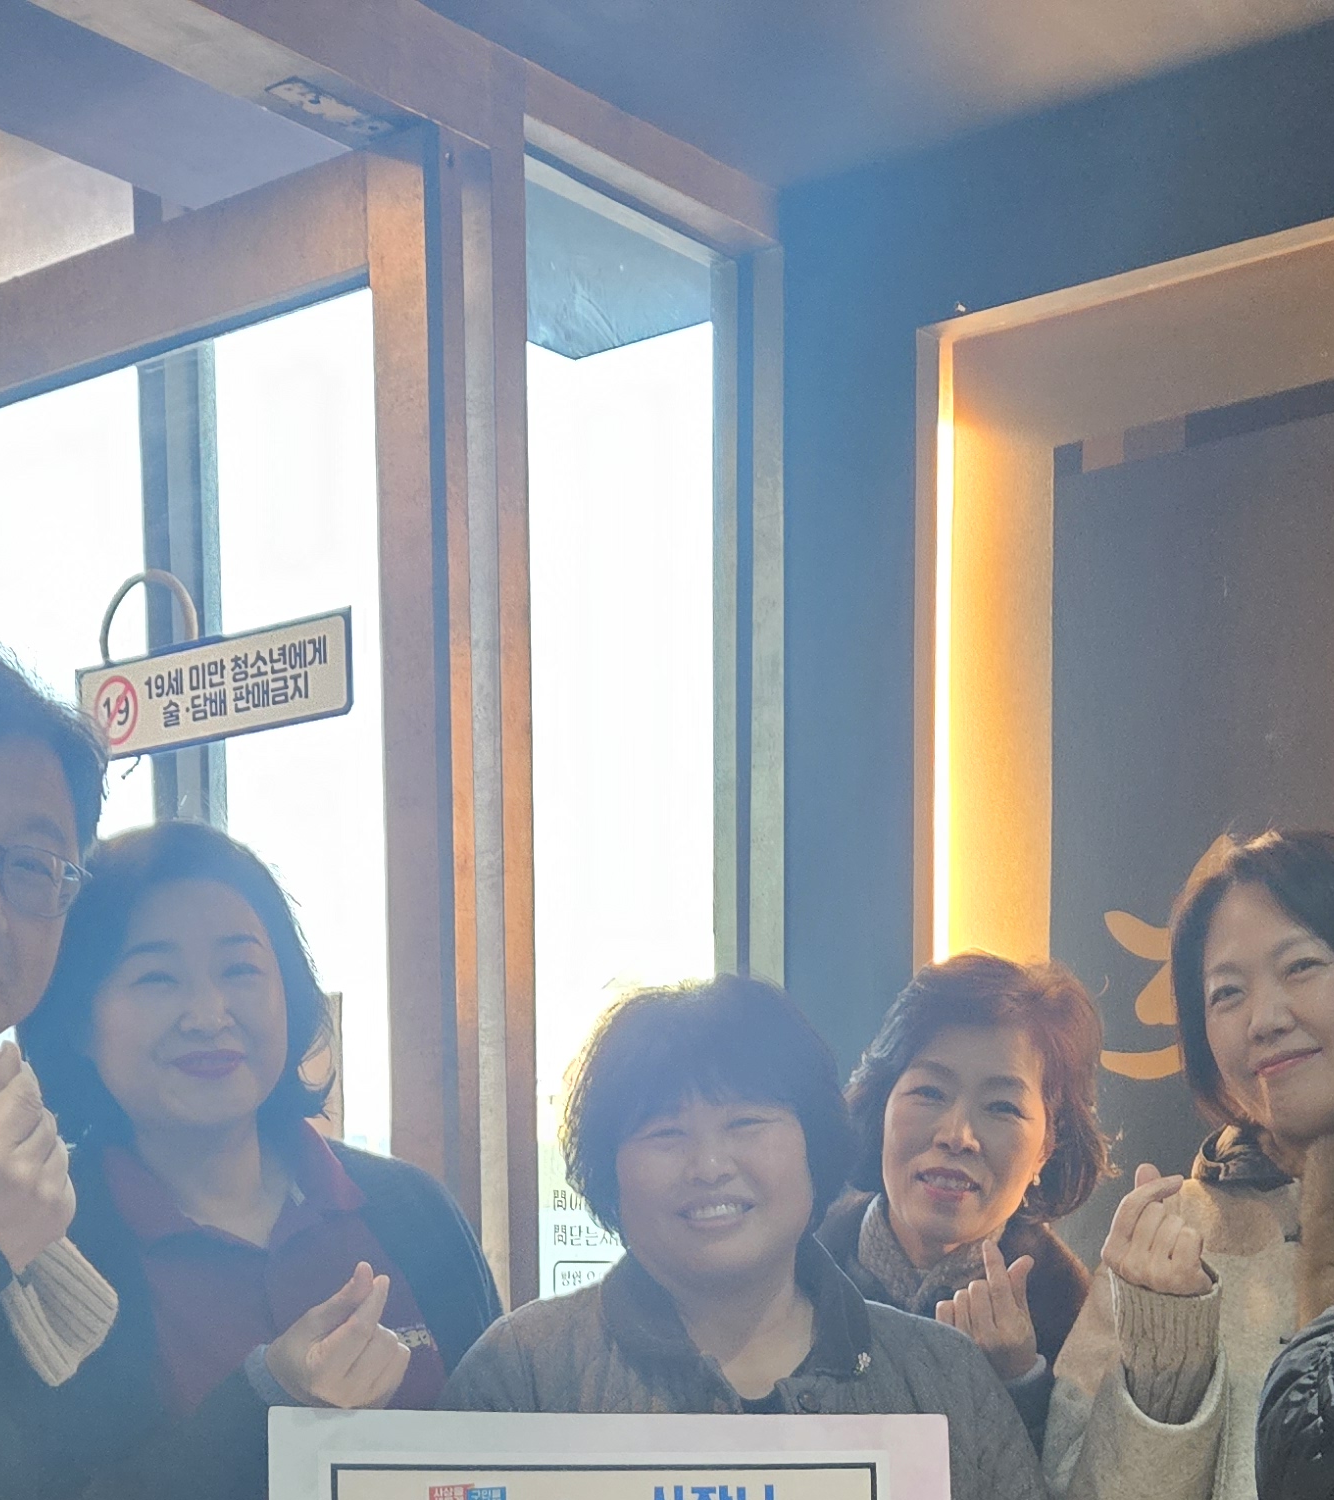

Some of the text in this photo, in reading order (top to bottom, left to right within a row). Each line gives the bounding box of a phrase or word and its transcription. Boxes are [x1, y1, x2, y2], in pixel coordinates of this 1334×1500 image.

[144, 634, 327, 700] 19세 미만 청소년에게
[232, 670, 309, 713] 판매금지
